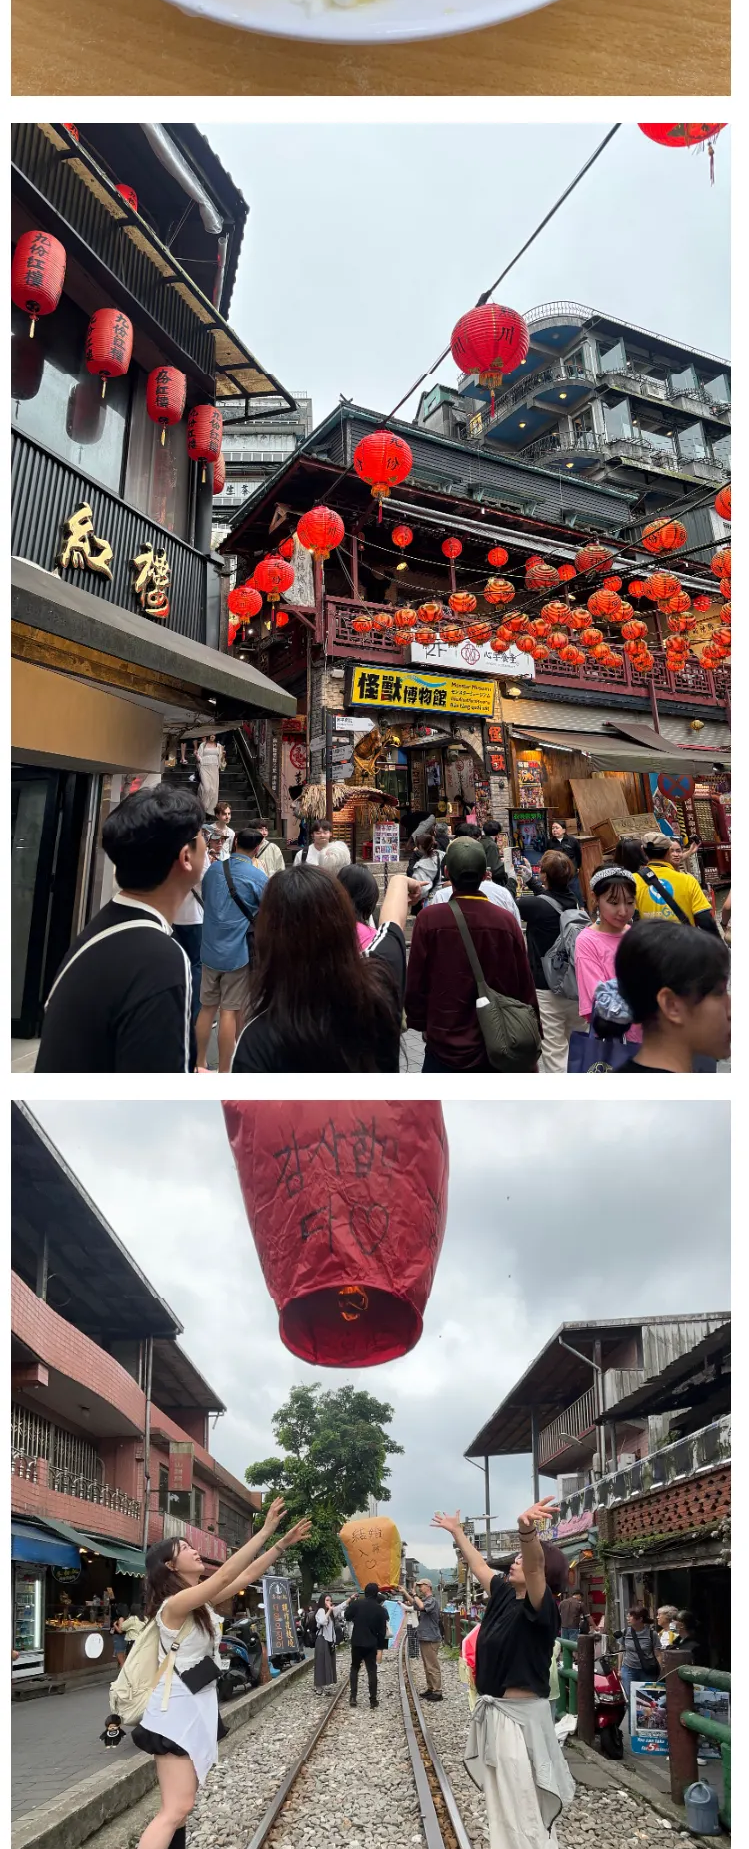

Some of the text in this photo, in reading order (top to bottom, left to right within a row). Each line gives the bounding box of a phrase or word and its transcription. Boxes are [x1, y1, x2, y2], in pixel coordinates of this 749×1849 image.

[358, 671, 448, 708] 怪獸博物館
[648, 1743, 656, 1751] 5
